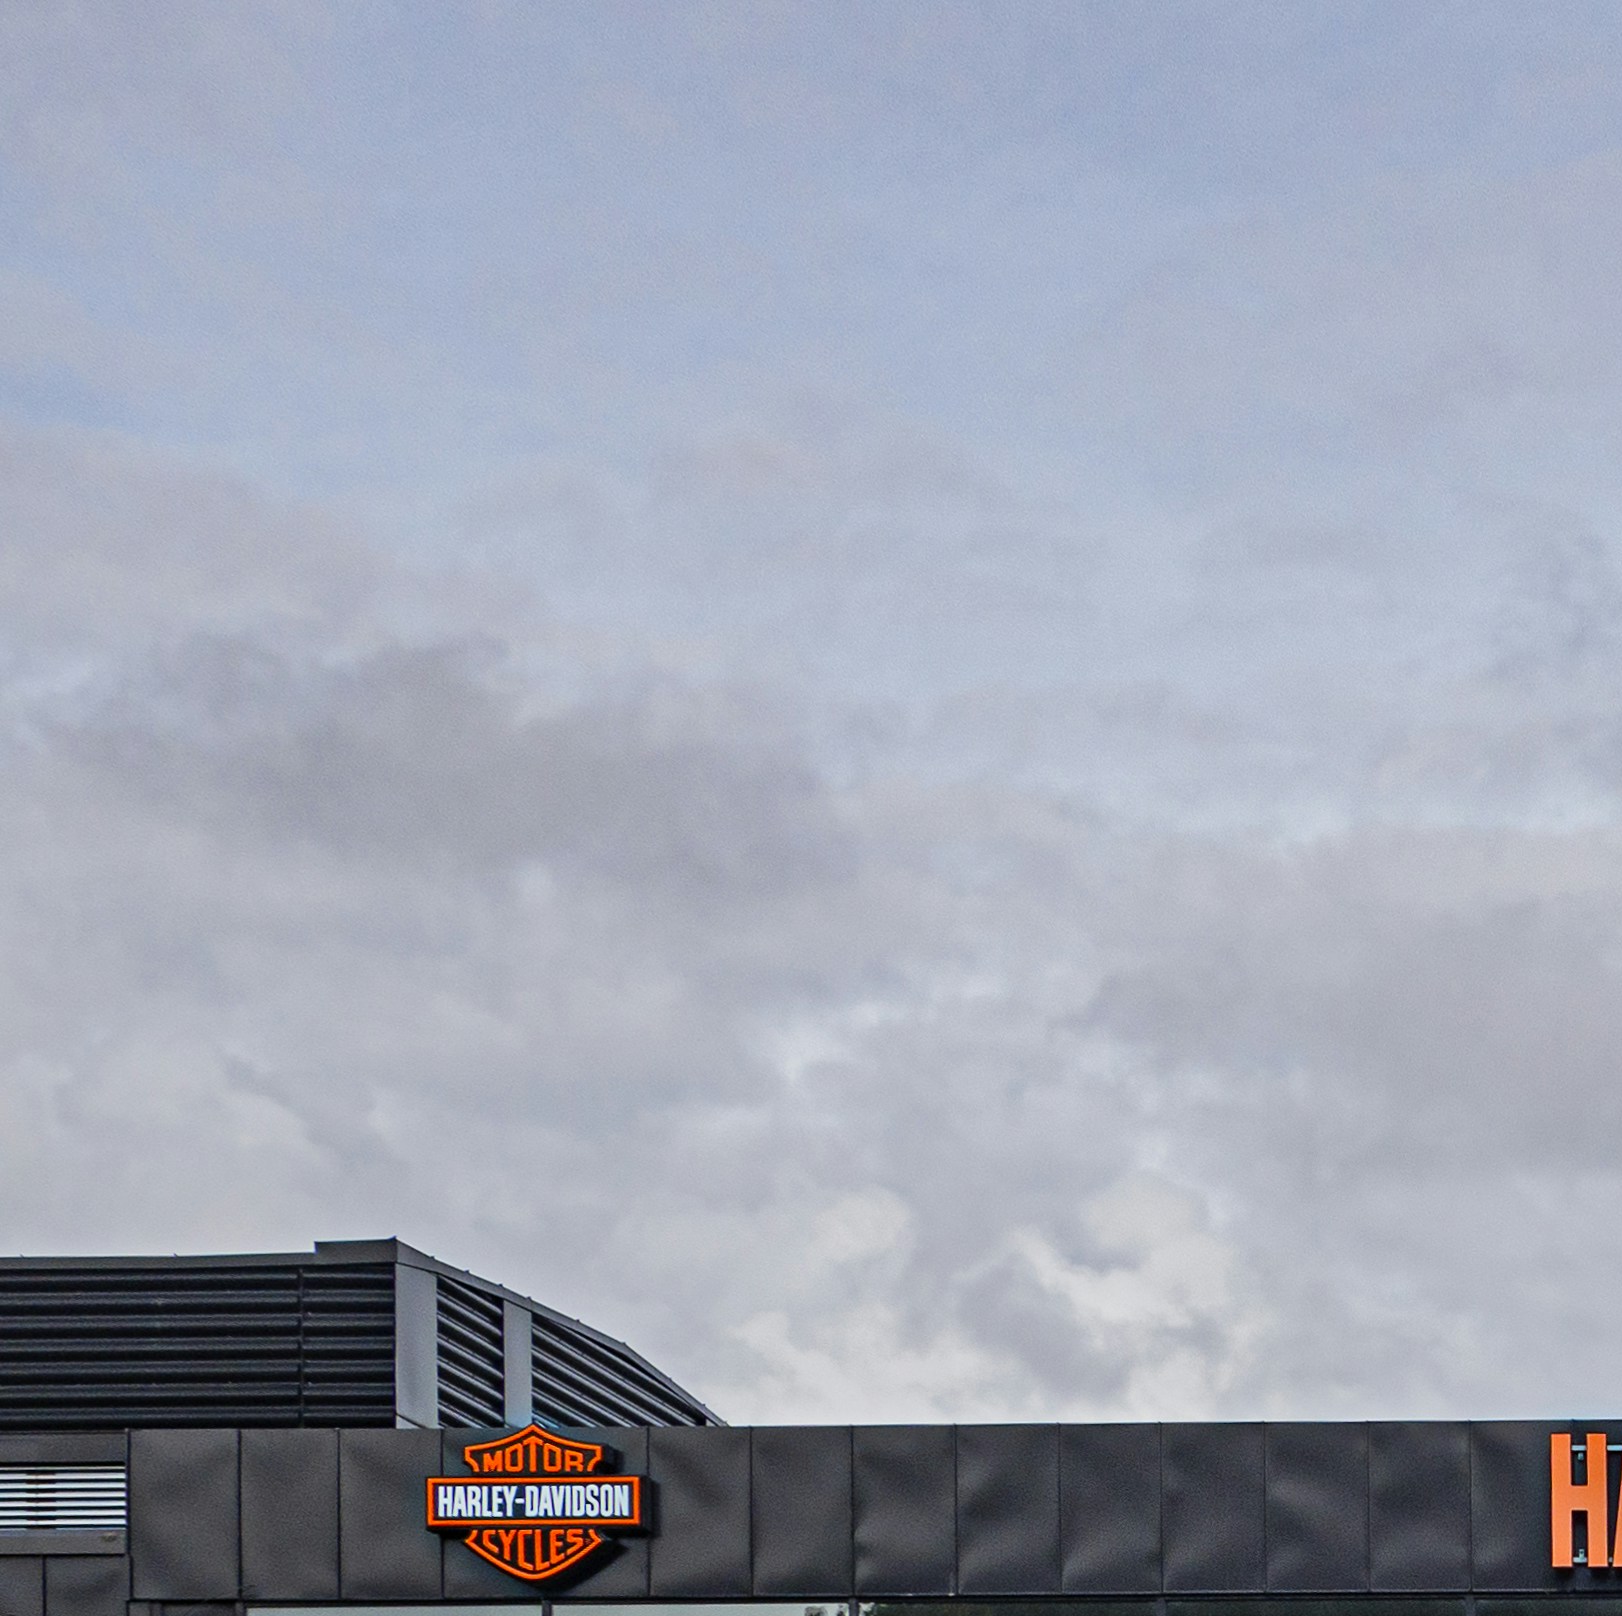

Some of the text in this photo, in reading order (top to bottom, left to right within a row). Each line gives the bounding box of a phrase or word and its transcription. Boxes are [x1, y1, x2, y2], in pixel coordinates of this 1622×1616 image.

[483, 1435, 584, 1473] MOTOR
[437, 1484, 630, 1518] HARLEY-DAVIDSON
[482, 1528, 584, 1571] CYCLES
